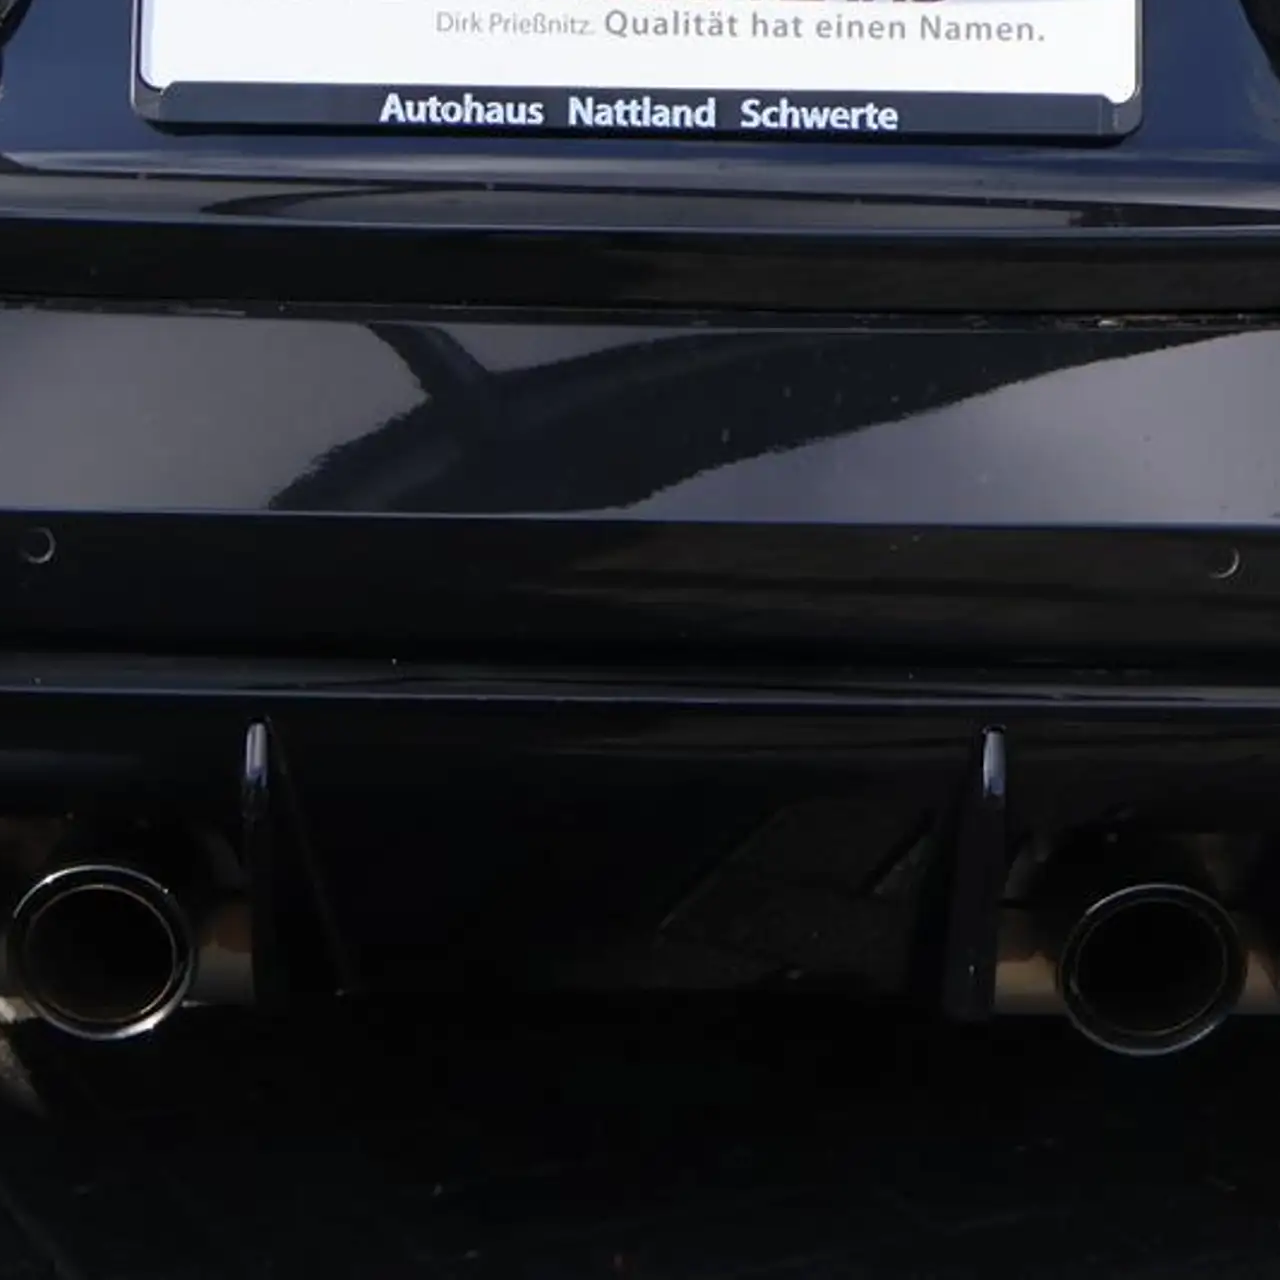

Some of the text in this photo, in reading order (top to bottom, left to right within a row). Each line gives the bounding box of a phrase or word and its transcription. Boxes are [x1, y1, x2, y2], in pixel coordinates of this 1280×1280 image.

[436, 12, 482, 35] Dirk
[605, 9, 738, 37] Qualität
[752, 15, 801, 38] hat
[818, 17, 907, 40] einen
[921, 17, 1046, 42] Namen.
[380, 93, 898, 131] Autohaus Nattland Schwerte
